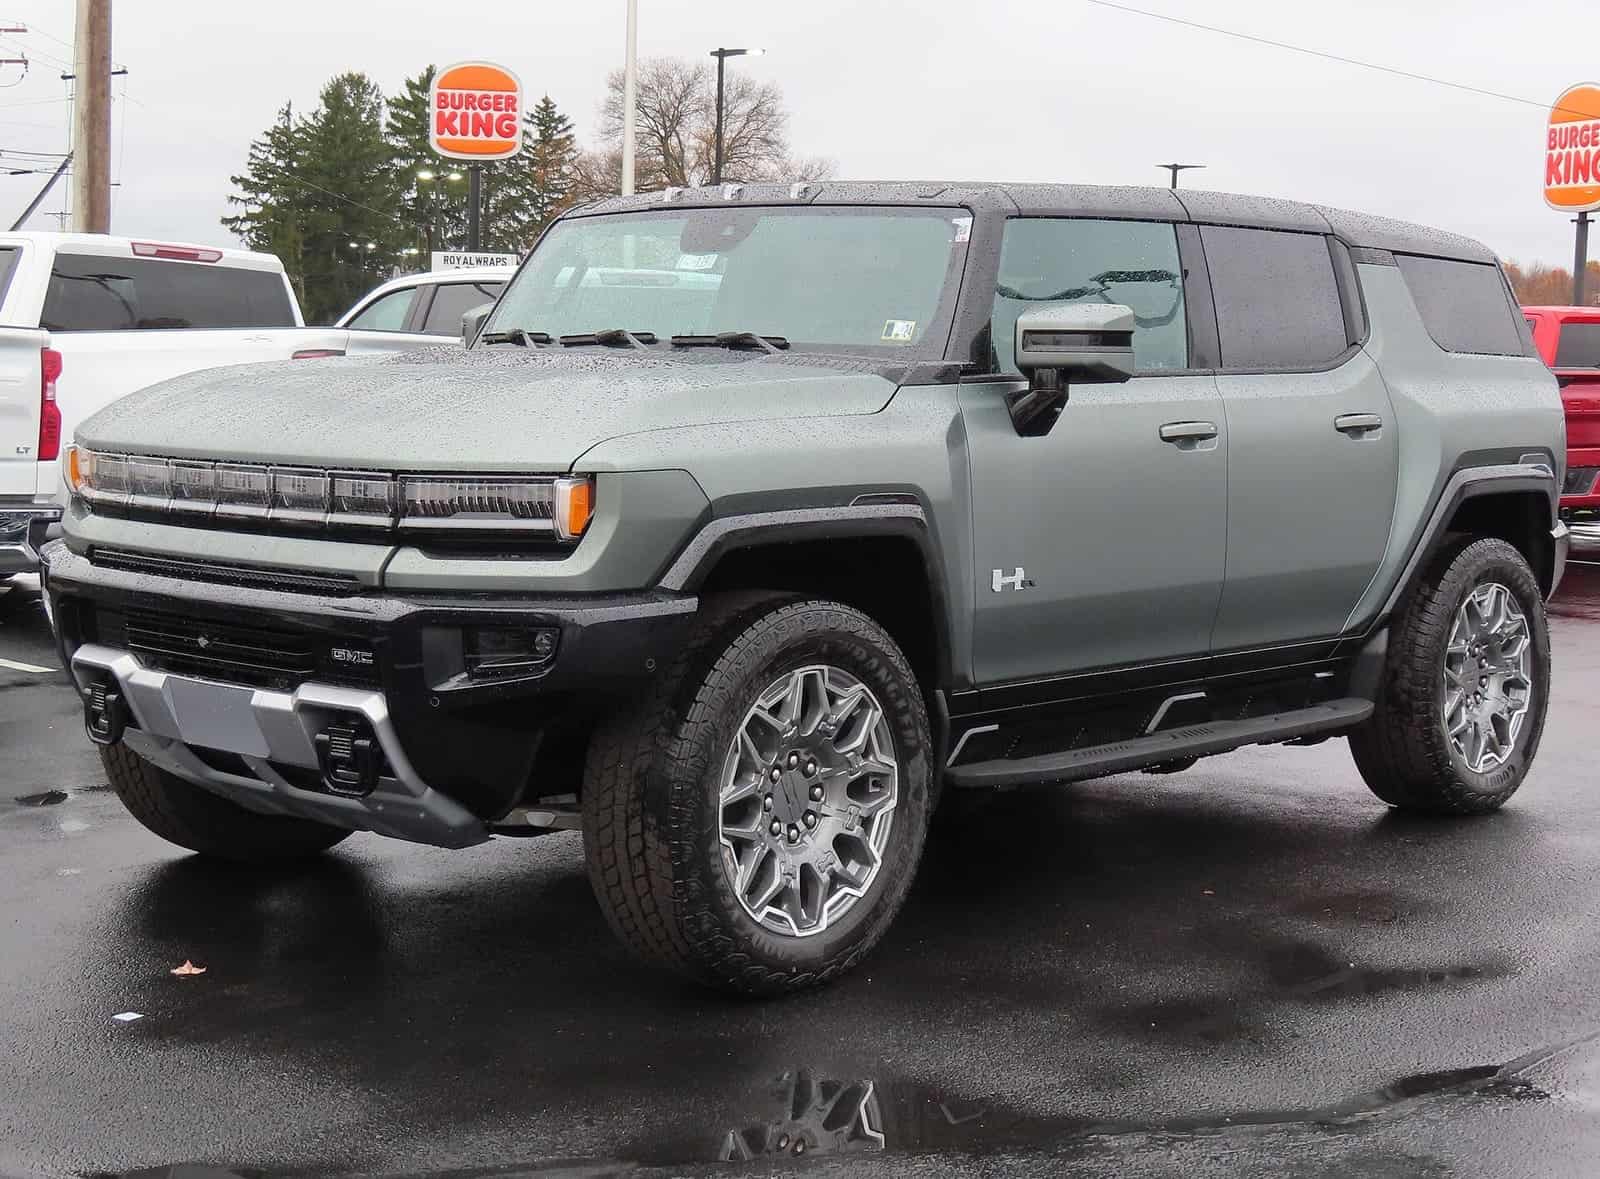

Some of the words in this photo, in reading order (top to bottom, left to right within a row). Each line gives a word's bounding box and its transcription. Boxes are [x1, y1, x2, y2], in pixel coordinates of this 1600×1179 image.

[437, 92, 517, 112] BURGER
[437, 111, 517, 138] KING
[1548, 123, 1600, 150] BURGE
[16, 446, 31, 454] LT
[332, 648, 373, 664] GMC
